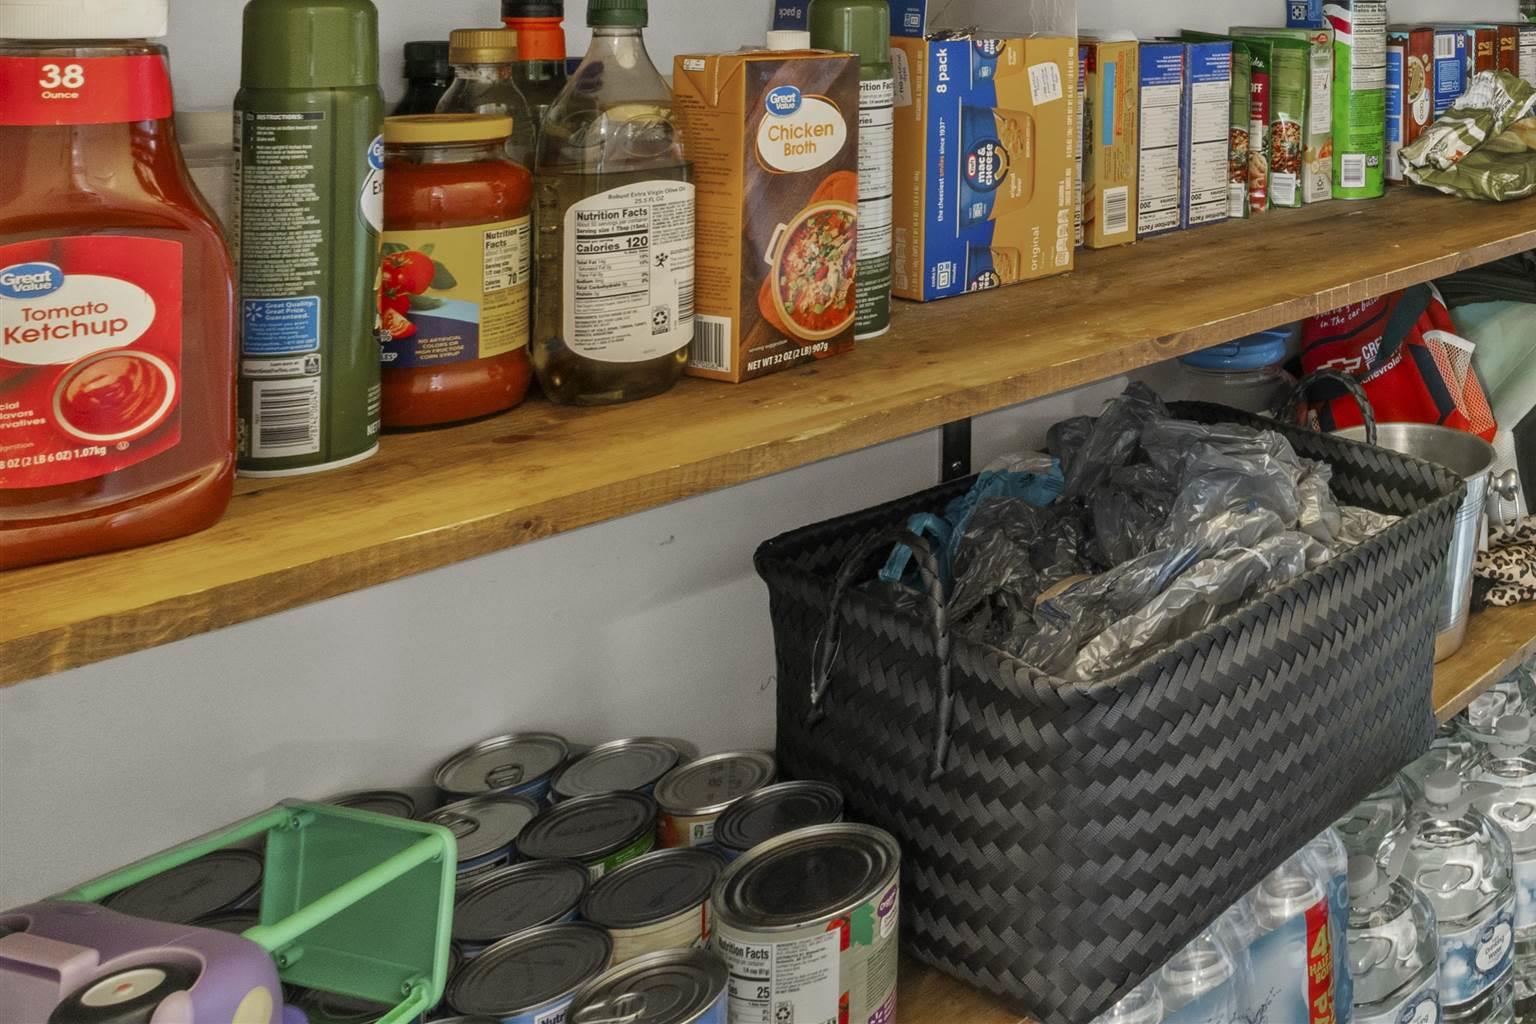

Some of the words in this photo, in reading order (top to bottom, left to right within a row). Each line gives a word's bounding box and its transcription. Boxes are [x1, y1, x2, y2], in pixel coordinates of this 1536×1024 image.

[778, 7, 796, 19] pack
[1478, 41, 1492, 56] 12
[1500, 37, 1515, 52] 12
[935, 47, 948, 81] pack
[39, 64, 85, 90] 38
[859, 82, 882, 92] rition
[936, 80, 947, 94] 8
[41, 90, 79, 100] Ounce
[769, 93, 796, 105] Great
[775, 101, 796, 111] Value
[256, 113, 304, 121] INSTRUCTIONS:
[767, 121, 834, 142] Chicken
[783, 141, 817, 157] Broth
[978, 146, 985, 156] &
[630, 190, 647, 198] Extra
[647, 189, 664, 198] Virgin
[1191, 193, 1202, 201] 200
[1140, 201, 1152, 209] 200
[576, 211, 620, 221] Nutrition
[622, 208, 648, 218] Facts
[485, 228, 518, 240] Nutrition
[485, 239, 507, 249] Facts
[576, 243, 620, 253] Calories
[626, 236, 648, 248] 120
[1031, 226, 1041, 271] original
[1, 270, 53, 287] Great
[507, 273, 518, 285] 70
[12, 279, 54, 293] Value
[21, 301, 109, 324] Tomato
[3, 317, 129, 346] Ketchup
[747, 359, 760, 372] NET
[761, 356, 773, 368] WT
[773, 353, 783, 365] 32
[783, 350, 793, 362] OZ
[793, 349, 800, 361] (2
[800, 347, 812, 359] LB)
[812, 342, 829, 356] 907g
[7, 456, 21, 469] OZ
[21, 454, 33, 469] (2
[33, 452, 46, 466] LB
[47, 451, 55, 463] 6
[55, 448, 73, 463] OZ)
[74, 444, 107, 461] 1.07kg
[1311, 923, 1328, 957] 4
[718, 936, 744, 957] Nutrition
[745, 948, 769, 960] Facts
[757, 986, 770, 999] 25
